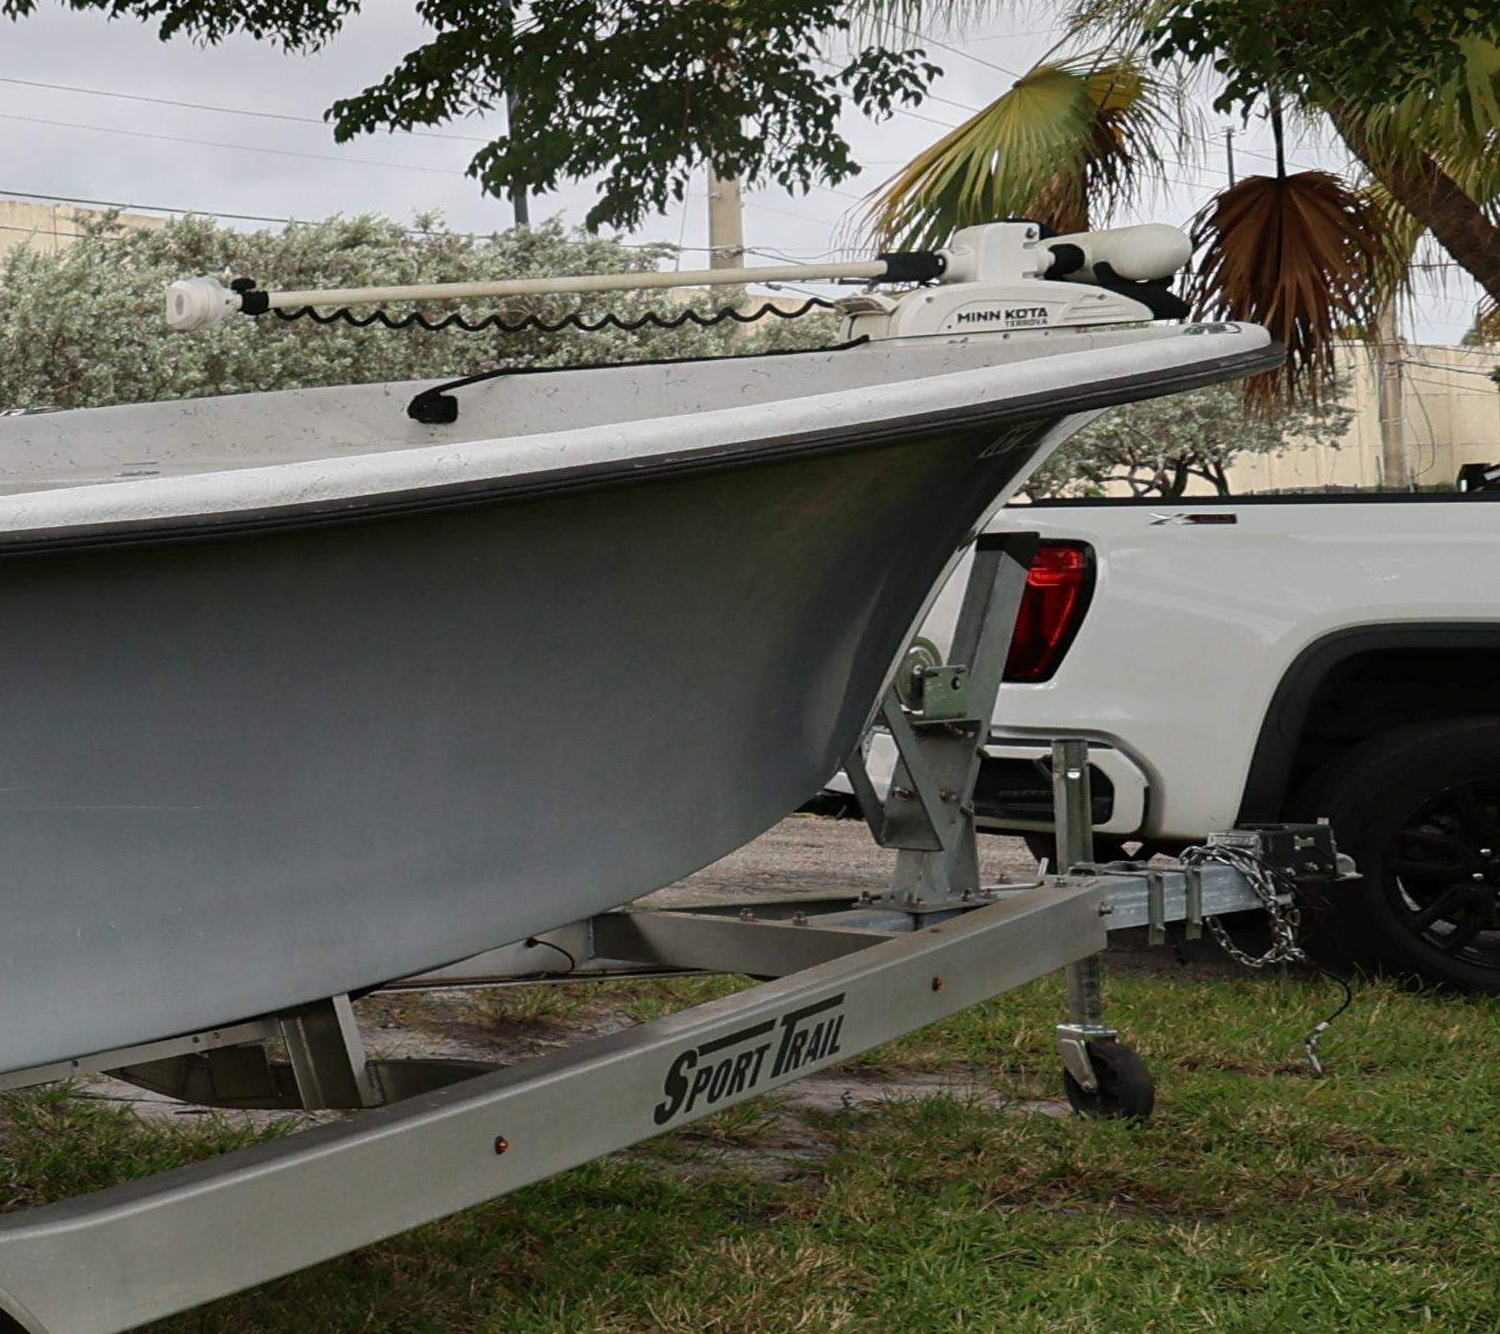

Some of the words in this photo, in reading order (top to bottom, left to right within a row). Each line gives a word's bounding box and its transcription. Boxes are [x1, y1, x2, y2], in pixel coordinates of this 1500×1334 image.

[957, 310, 1001, 323] MINN
[1004, 307, 1048, 320] KOTA
[654, 1018, 777, 1126] SPORT
[770, 992, 846, 1079] TRAIL
